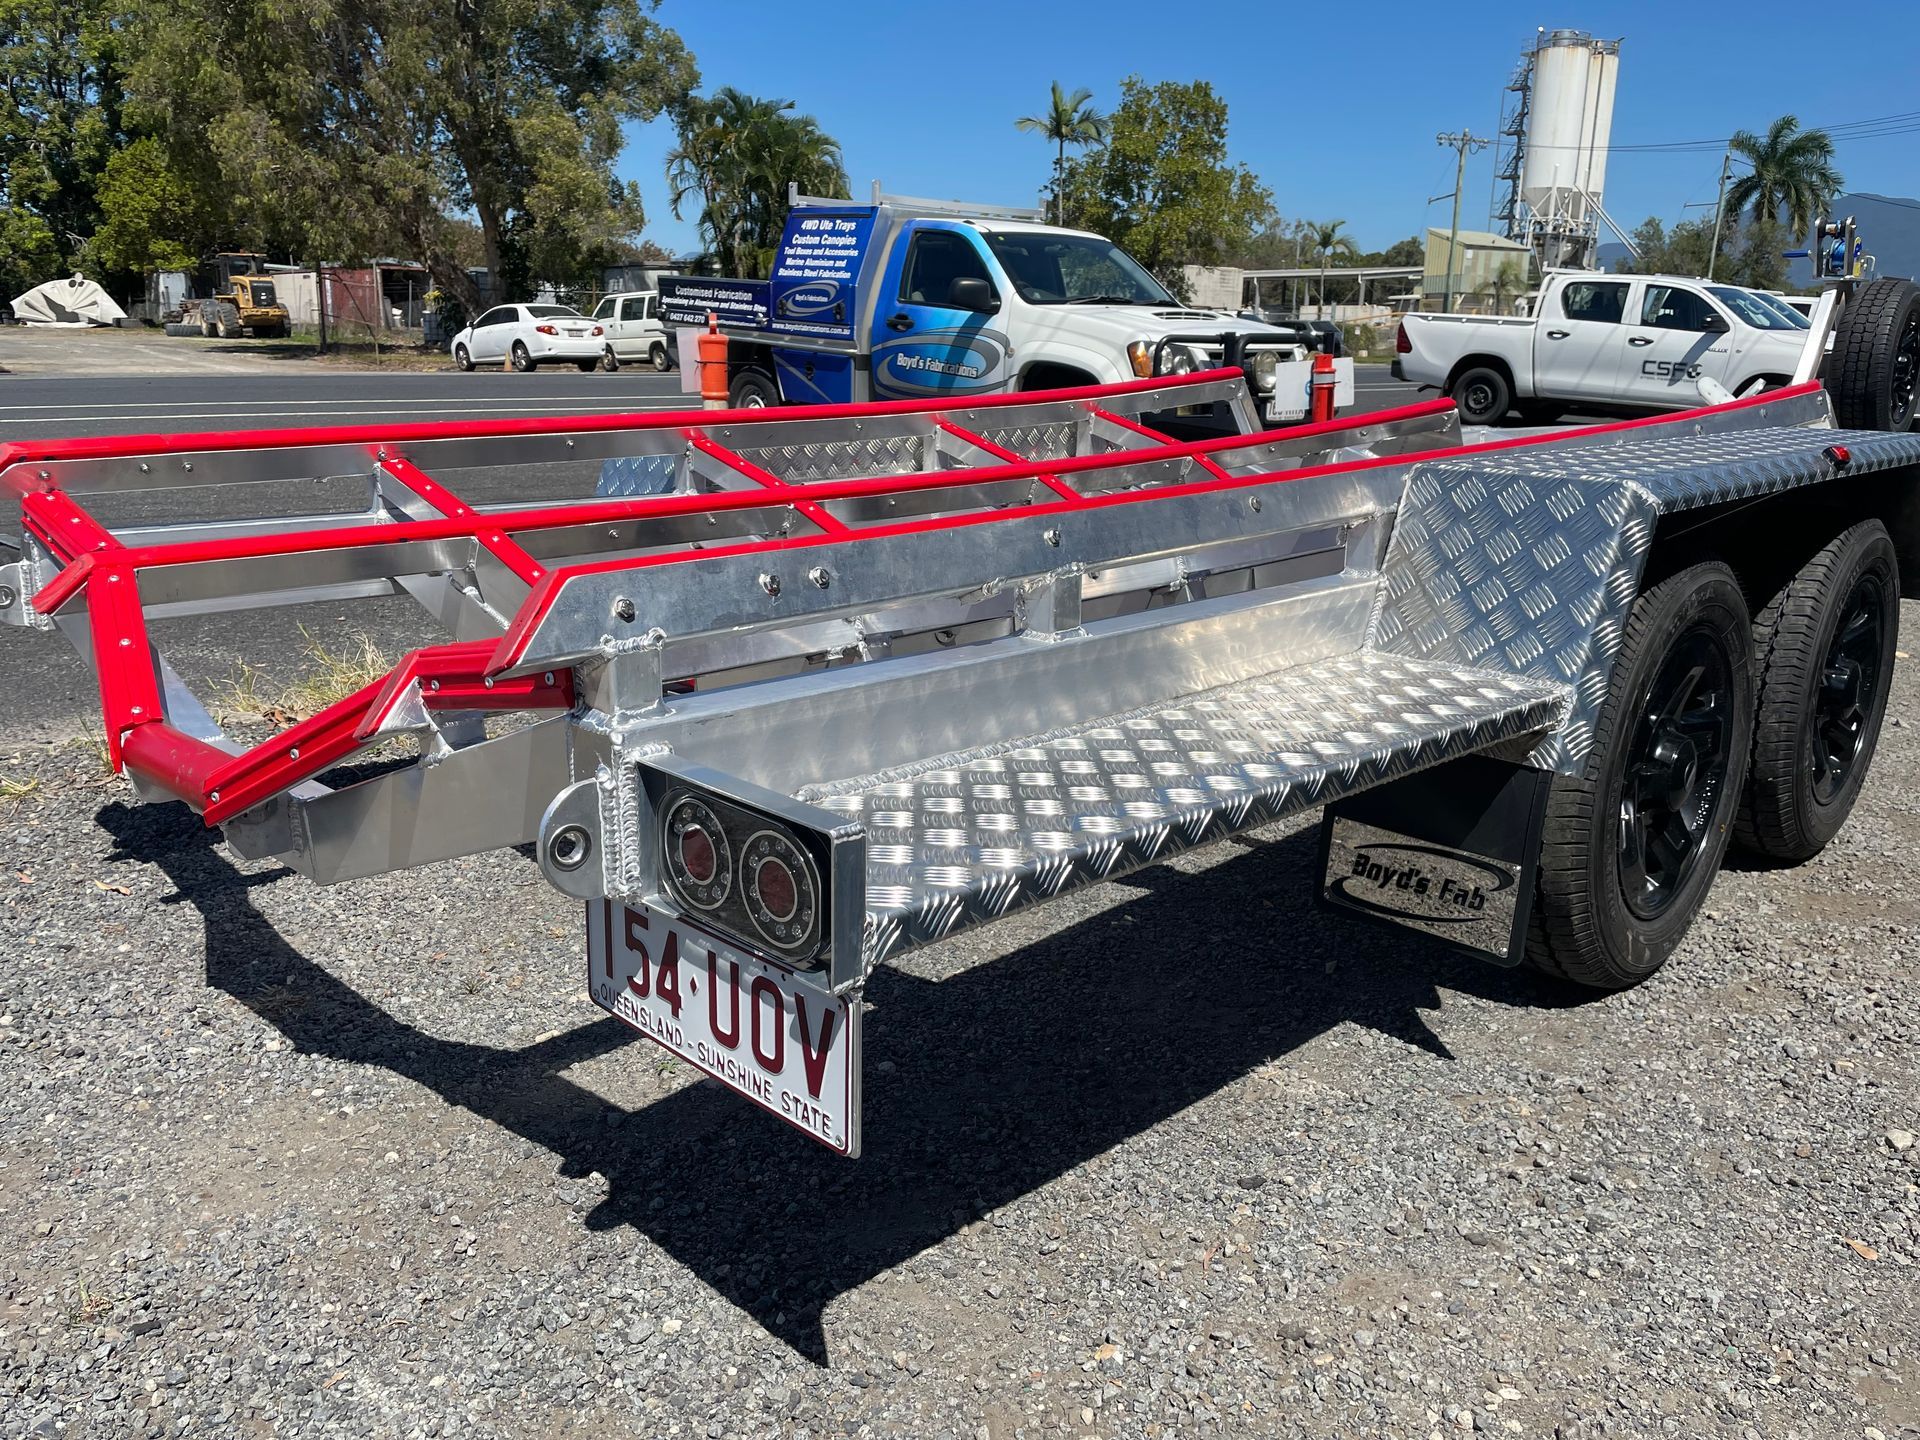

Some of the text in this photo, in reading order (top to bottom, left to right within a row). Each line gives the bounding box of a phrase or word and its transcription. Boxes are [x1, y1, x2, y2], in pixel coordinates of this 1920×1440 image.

[801, 219, 857, 232] 4WD Ute Trays
[792, 234, 857, 247] Custom Canopies
[784, 247, 796, 255] Tool
[812, 248, 825, 256] and
[824, 248, 859, 256] Accessories
[785, 258, 805, 266] Marine
[834, 259, 847, 267] and
[778, 268, 852, 279] Stainless Steel Fabrication
[675, 285, 753, 301] Customised Fabrication
[719, 301, 730, 309] and
[729, 302, 753, 311] Stainless
[683, 314, 695, 322] 642
[896, 353, 978, 378] Boyd's Fabrications
[1351, 853, 1486, 911] Boyd's Fab
[600, 983, 683, 1048] QUEENSLAND
[697, 1041, 774, 1103] SUNSHINE
[781, 1090, 832, 1137] STATE
